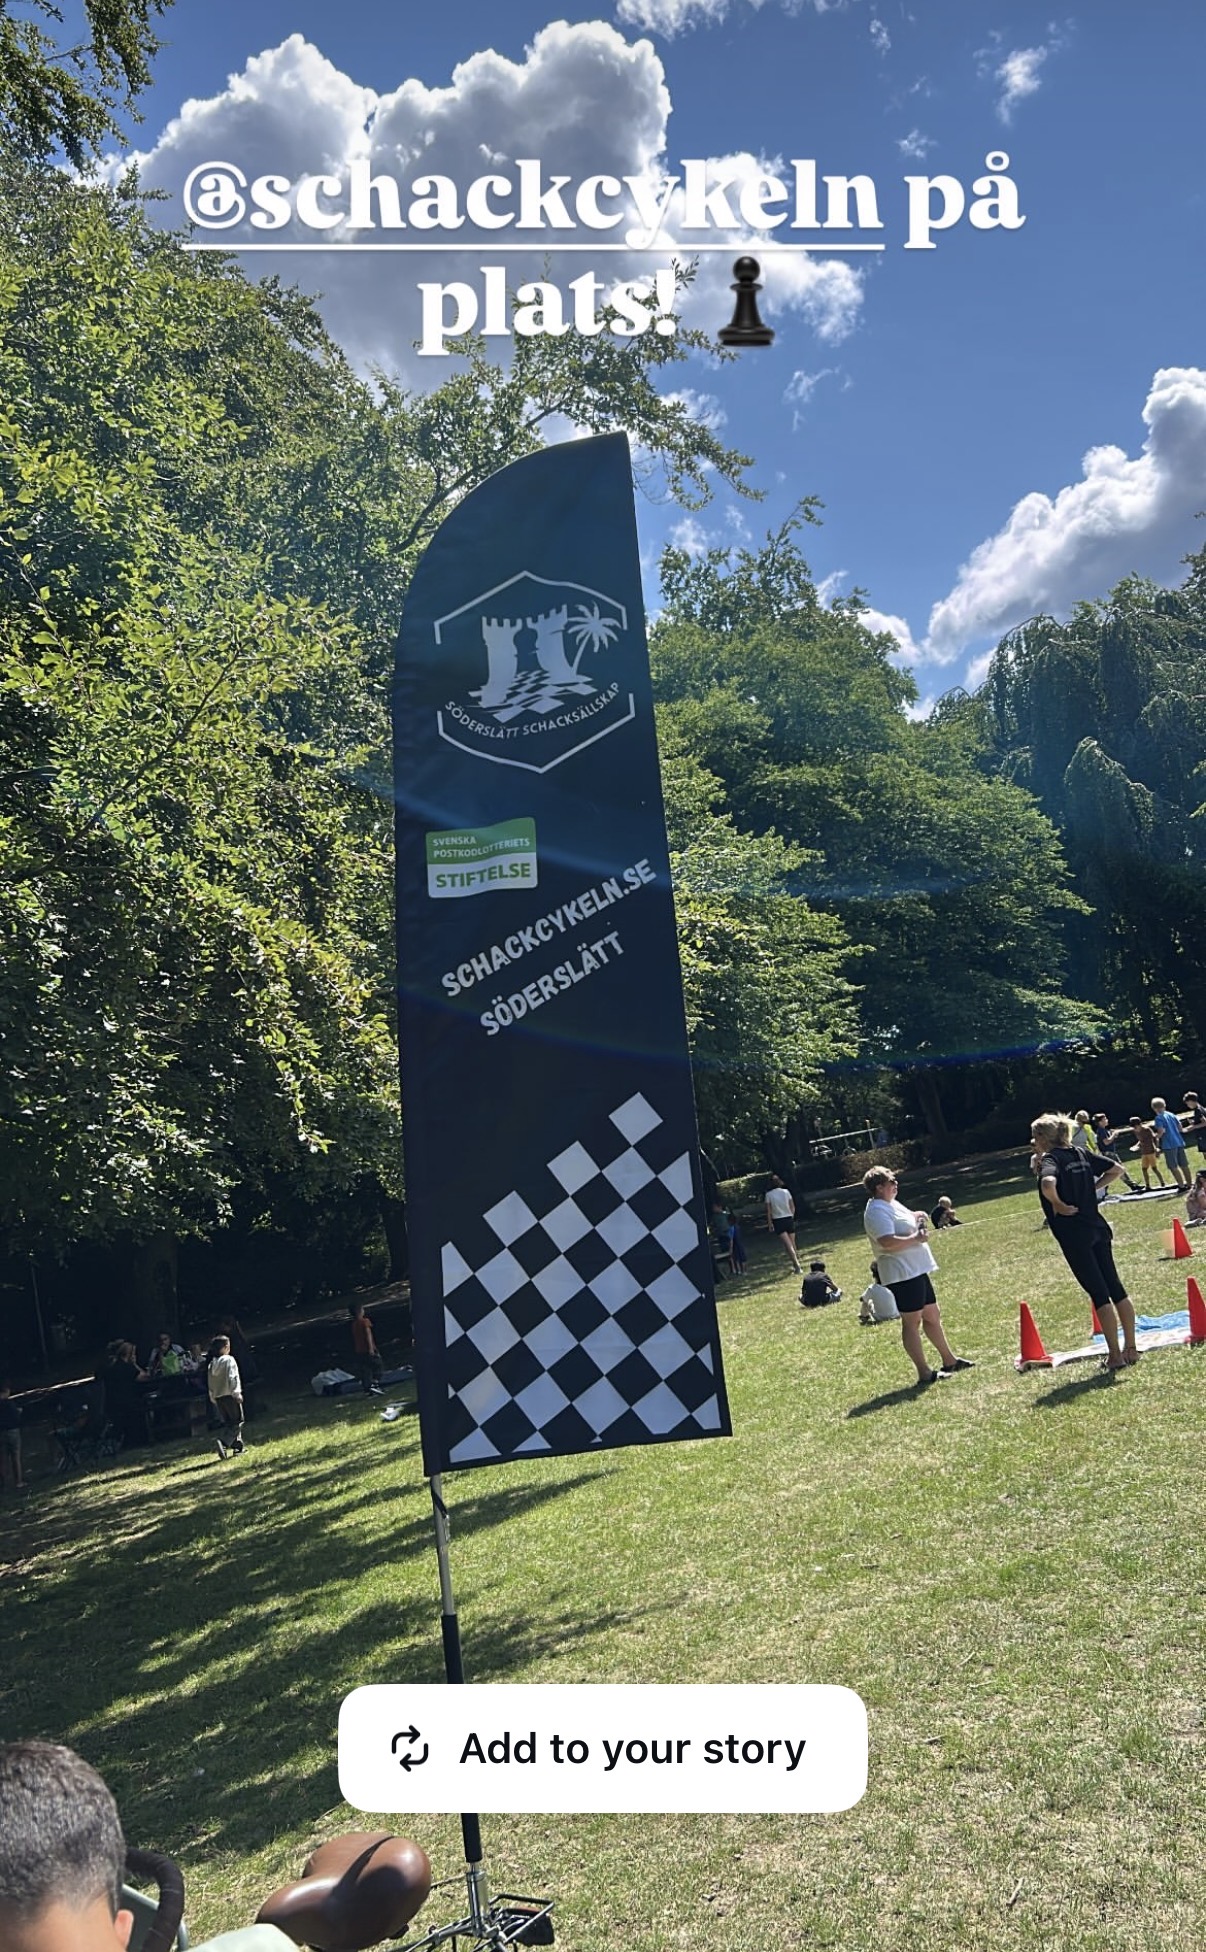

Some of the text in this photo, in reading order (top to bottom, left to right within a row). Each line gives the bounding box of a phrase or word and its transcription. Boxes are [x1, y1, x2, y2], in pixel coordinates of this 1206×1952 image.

[445, 682, 619, 738] SÖDERSLÄTT SCHACKSÄLLSKAP
[433, 836, 476, 847] SVENSKA
[433, 838, 530, 858] POSTKODLOTTERIETS
[436, 863, 531, 888] STIFTELSE
[441, 859, 657, 997] SCHACKCYKELN.SE
[480, 931, 624, 1036] SÖDERSLÄTT
